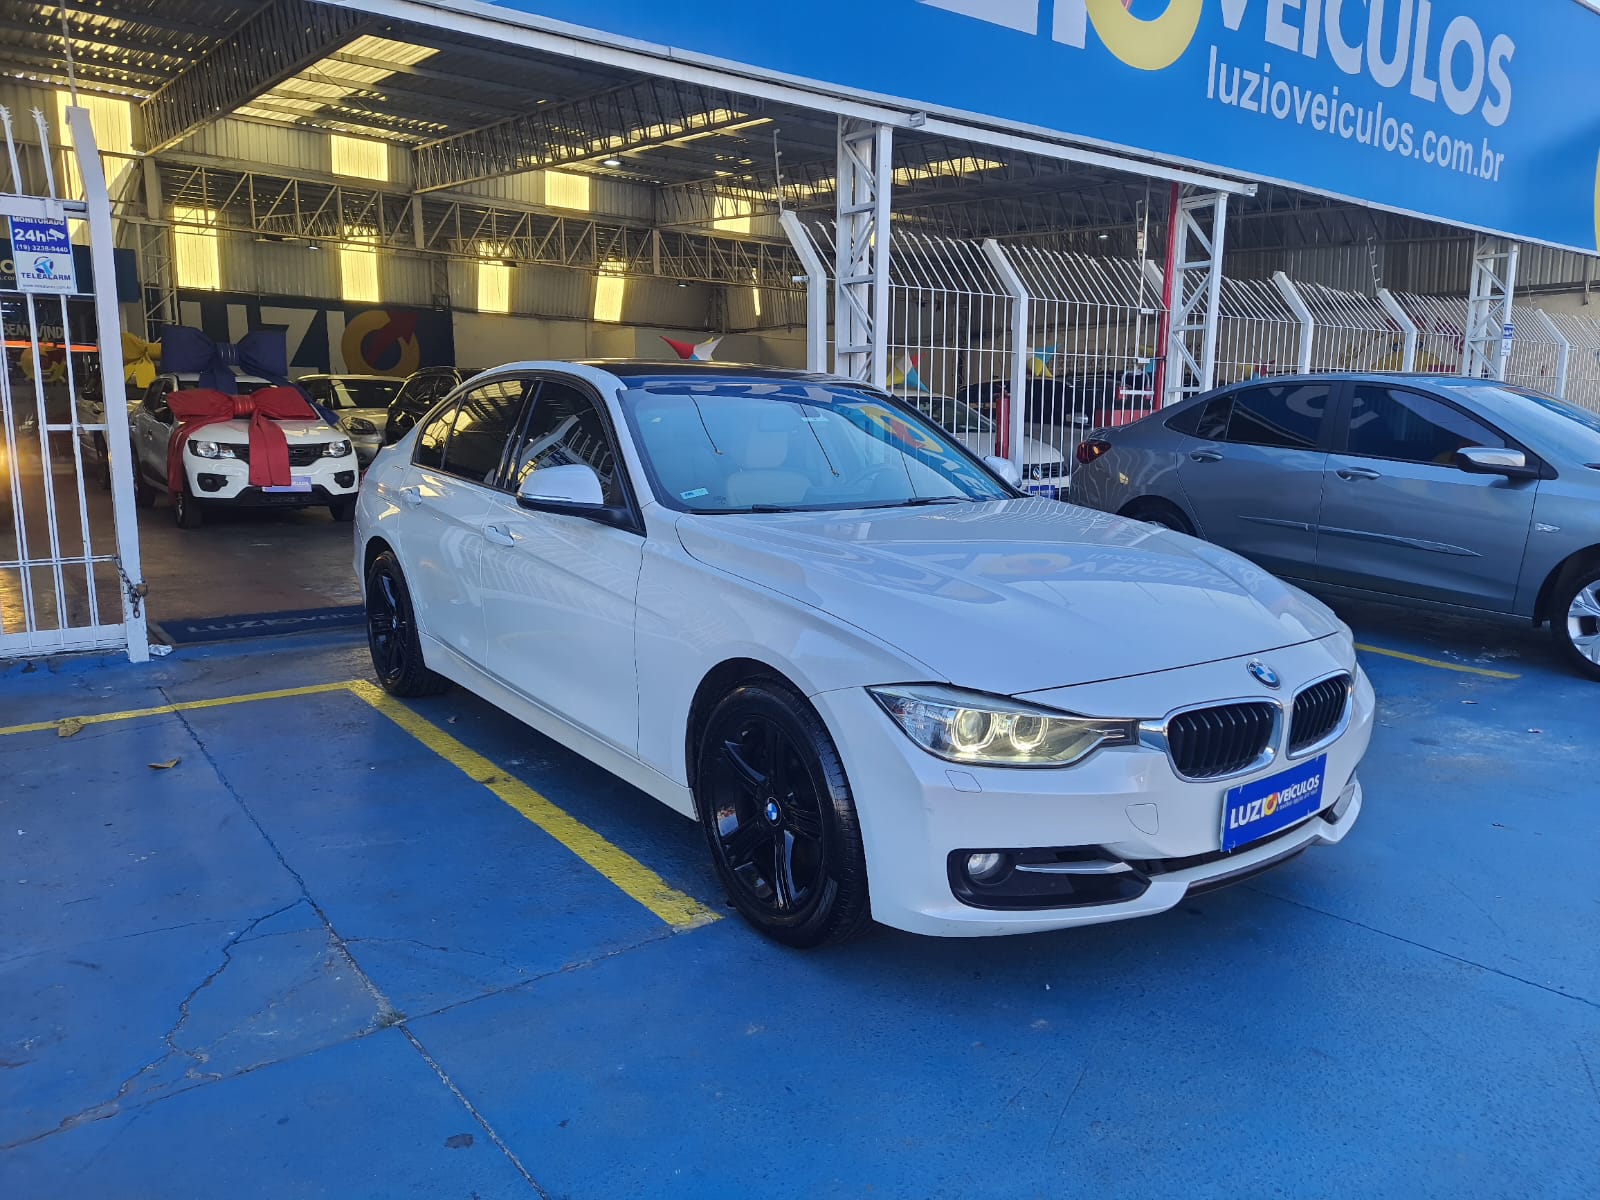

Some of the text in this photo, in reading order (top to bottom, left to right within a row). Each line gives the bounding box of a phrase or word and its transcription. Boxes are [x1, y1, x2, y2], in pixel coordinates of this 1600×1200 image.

[1221, 0, 1516, 127] ICULOS
[1206, 45, 1505, 182] luzioveiculos.com.br
[14, 228, 46, 242] 24h
[21, 272, 71, 280] TELEALARM
[38, 325, 71, 339] VIND
[1229, 792, 1279, 830] LUZIO
